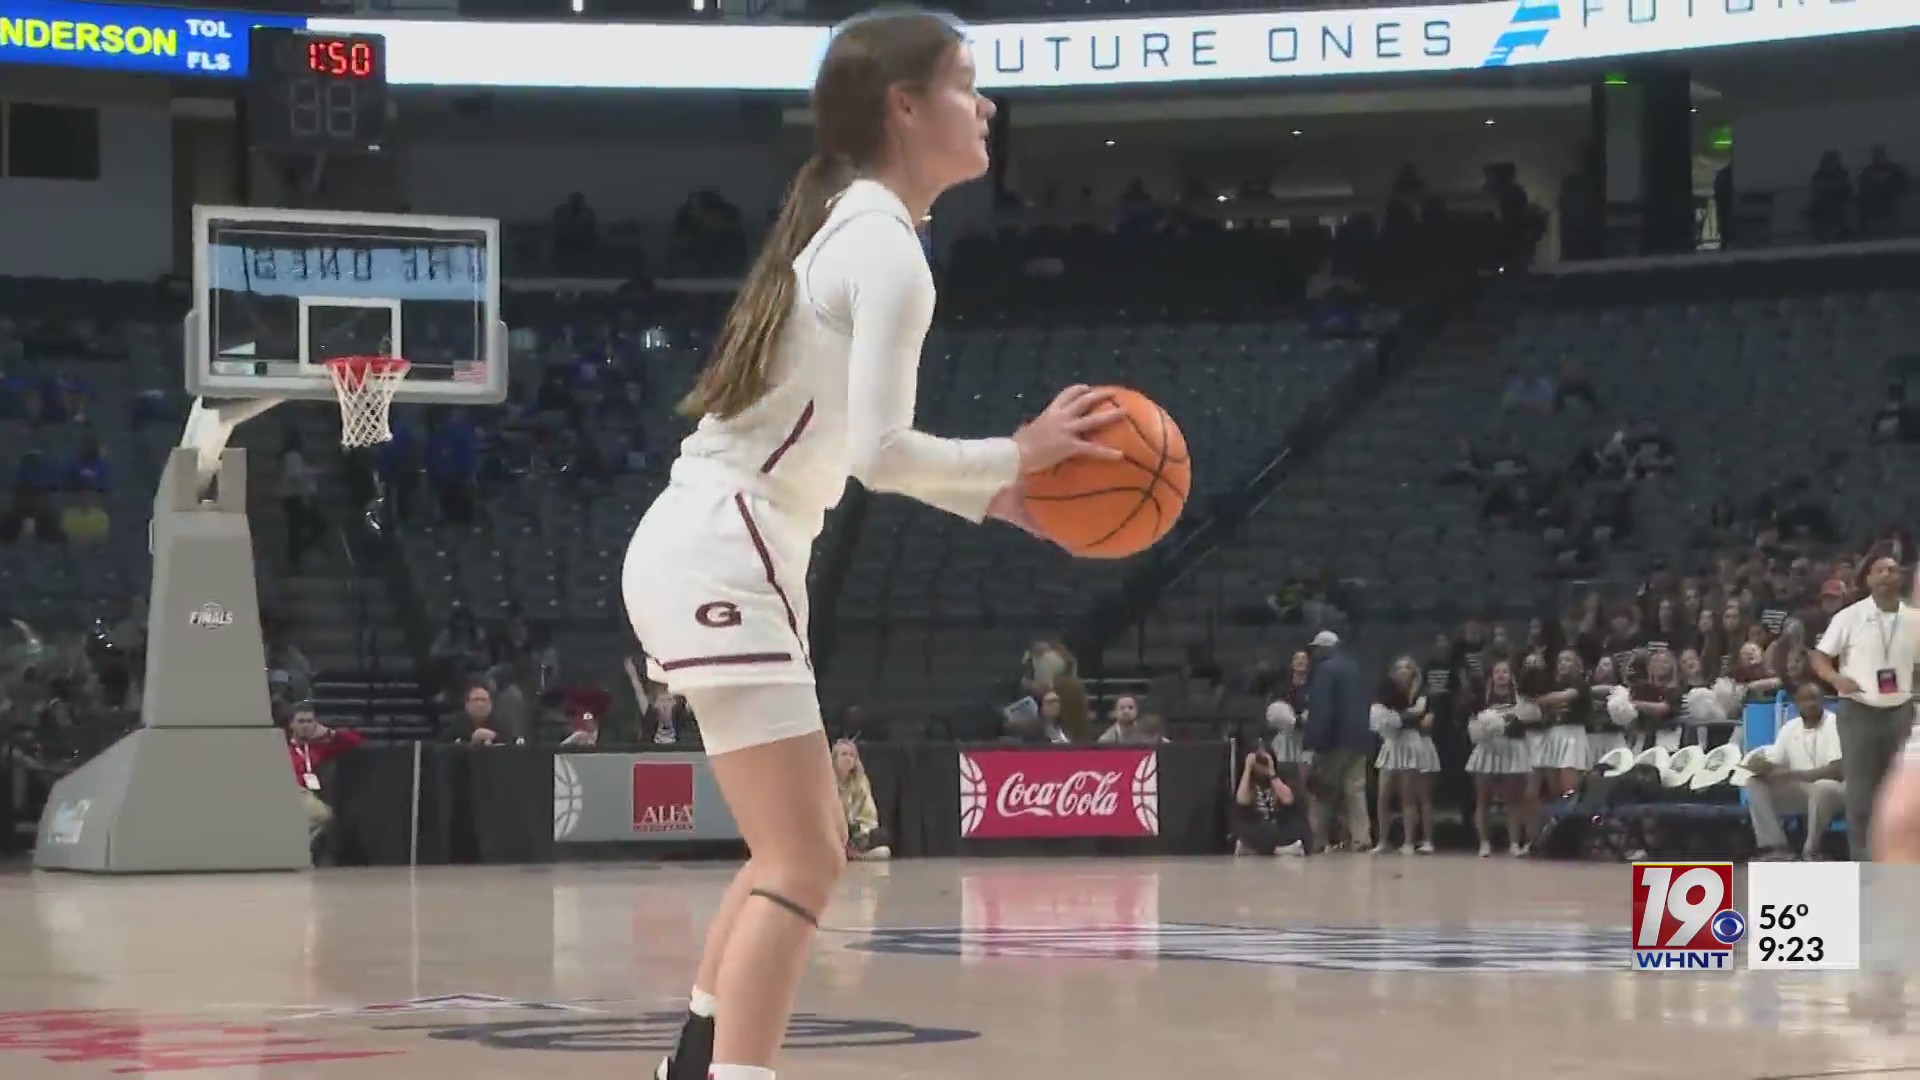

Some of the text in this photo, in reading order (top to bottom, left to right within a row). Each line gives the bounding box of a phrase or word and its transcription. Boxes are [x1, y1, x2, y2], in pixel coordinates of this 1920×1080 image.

[185, 18, 232, 38] TOL
[186, 51, 231, 70] FLS
[309, 42, 370, 74] 1:50
[965, 20, 1452, 72] UTURE ONES
[695, 601, 742, 627] G
[996, 771, 1122, 818] Coca-Cola
